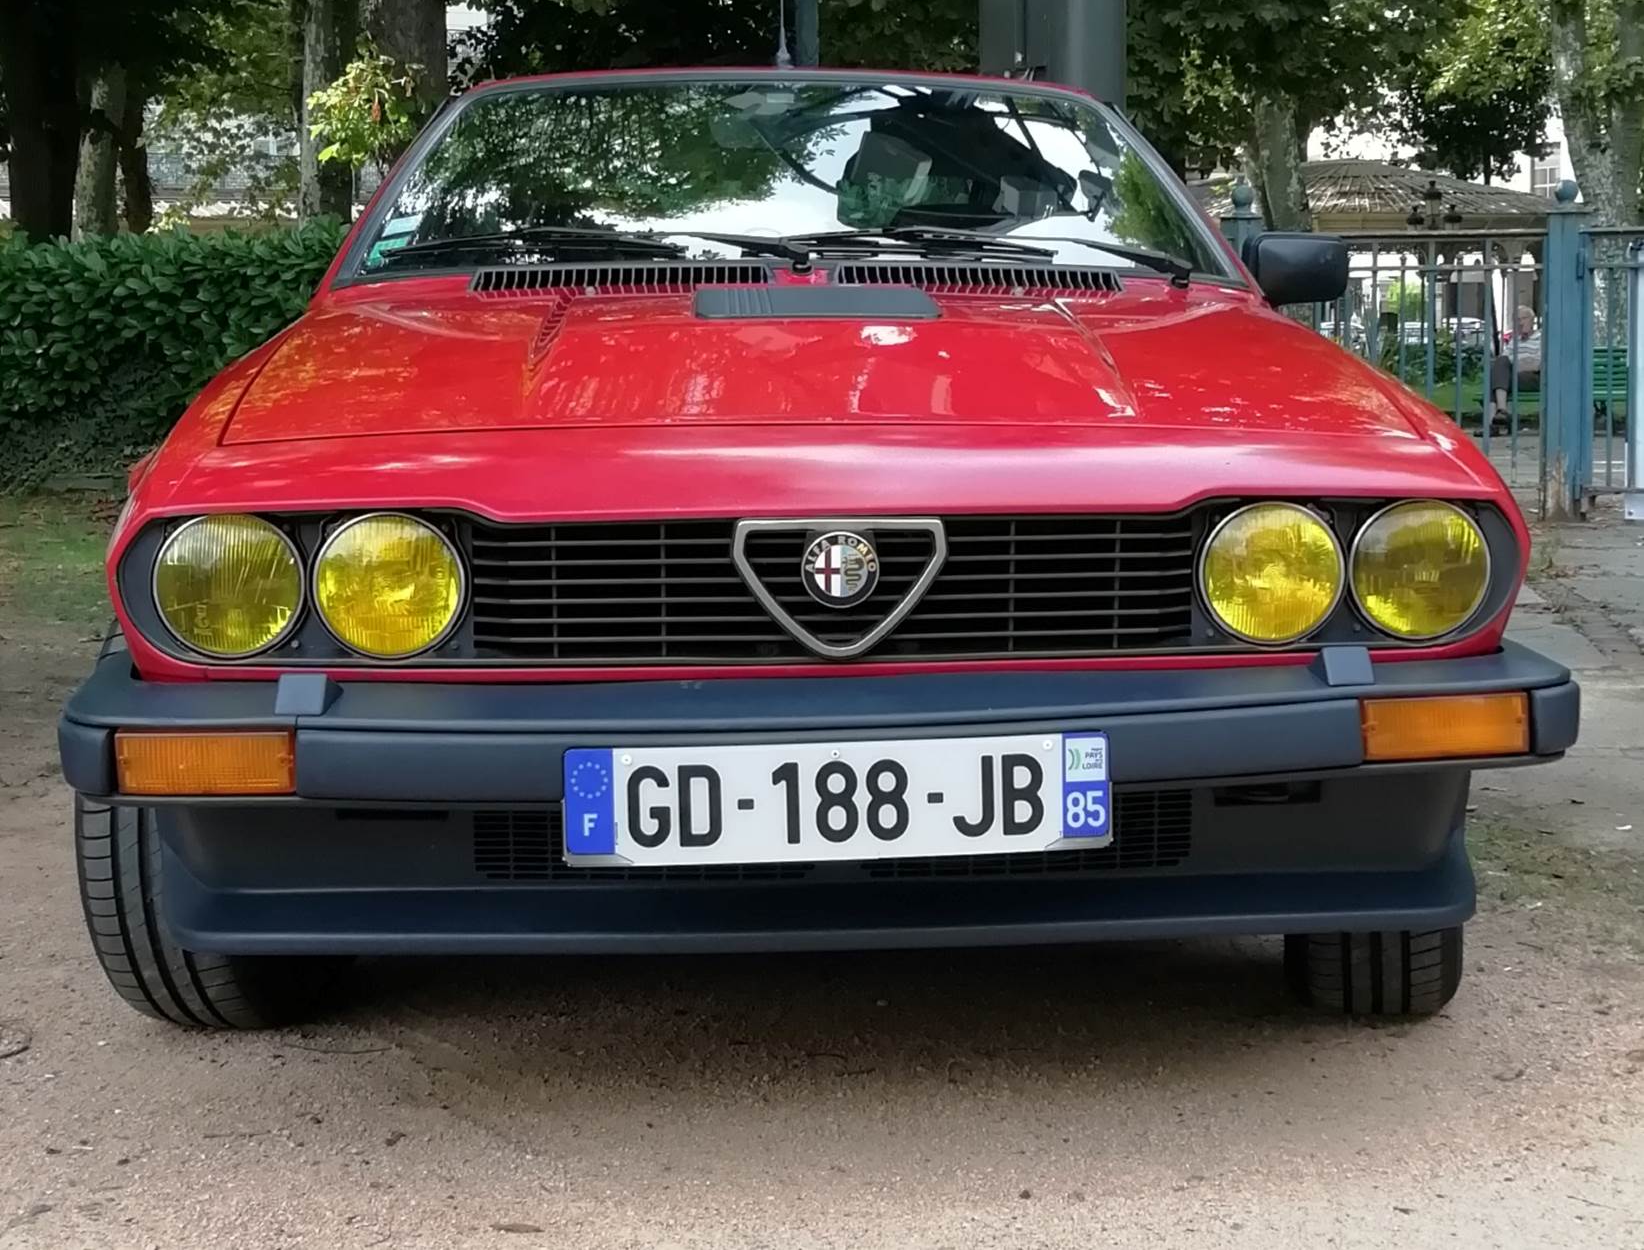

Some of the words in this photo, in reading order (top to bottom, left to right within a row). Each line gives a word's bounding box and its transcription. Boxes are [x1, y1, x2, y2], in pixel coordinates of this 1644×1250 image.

[805, 539, 831, 574] ALFA
[838, 535, 877, 572] ROMEO
[627, 753, 1044, 848] GD-188-JB
[1066, 791, 1106, 828] 85
[583, 813, 598, 837] F
